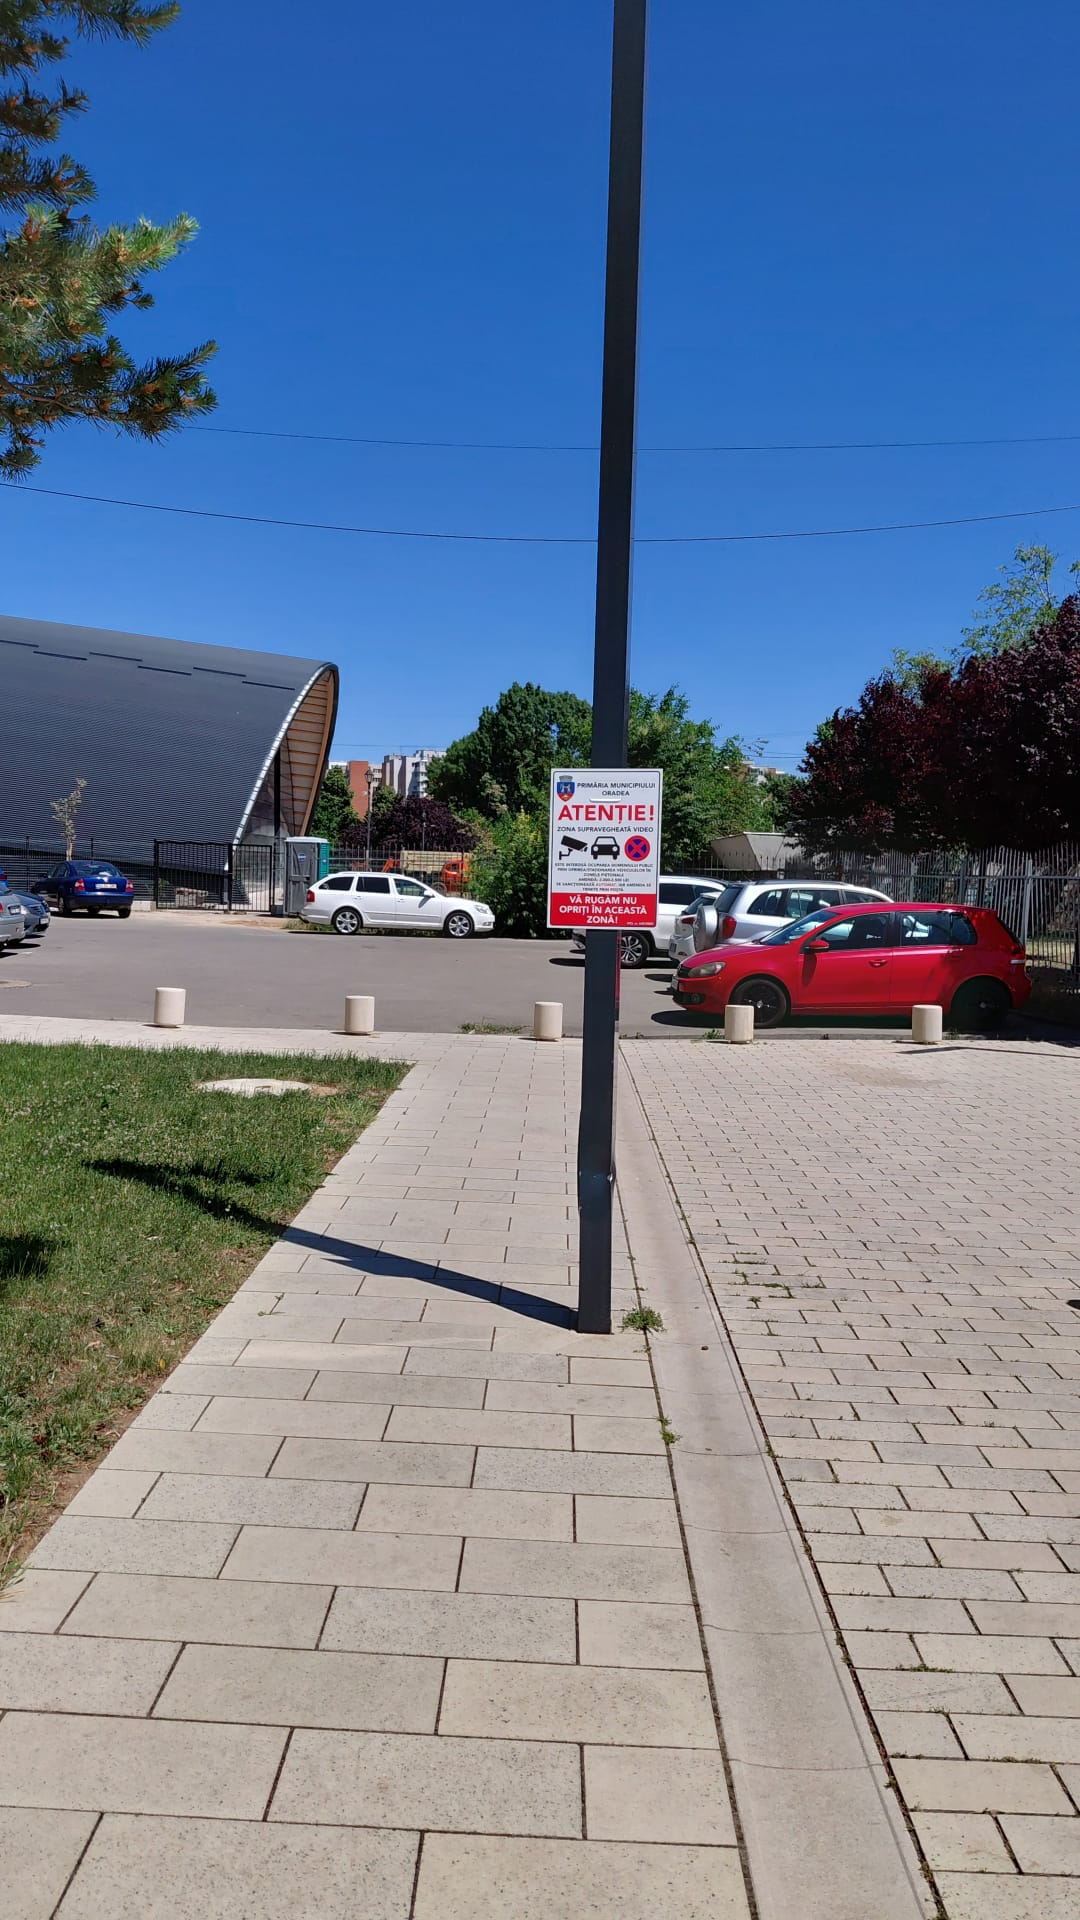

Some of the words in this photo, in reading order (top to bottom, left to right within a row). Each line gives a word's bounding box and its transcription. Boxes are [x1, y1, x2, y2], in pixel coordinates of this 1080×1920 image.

[558, 805, 654, 824] ATENȚIE!
[570, 895, 582, 904] VĂ
[585, 896, 620, 904] RUGĂM
[559, 905, 589, 915] OPRIȚI
[592, 905, 602, 913] ÎN
[605, 906, 647, 914] ACEASTĂ
[587, 916, 618, 924] ZONĂ!
